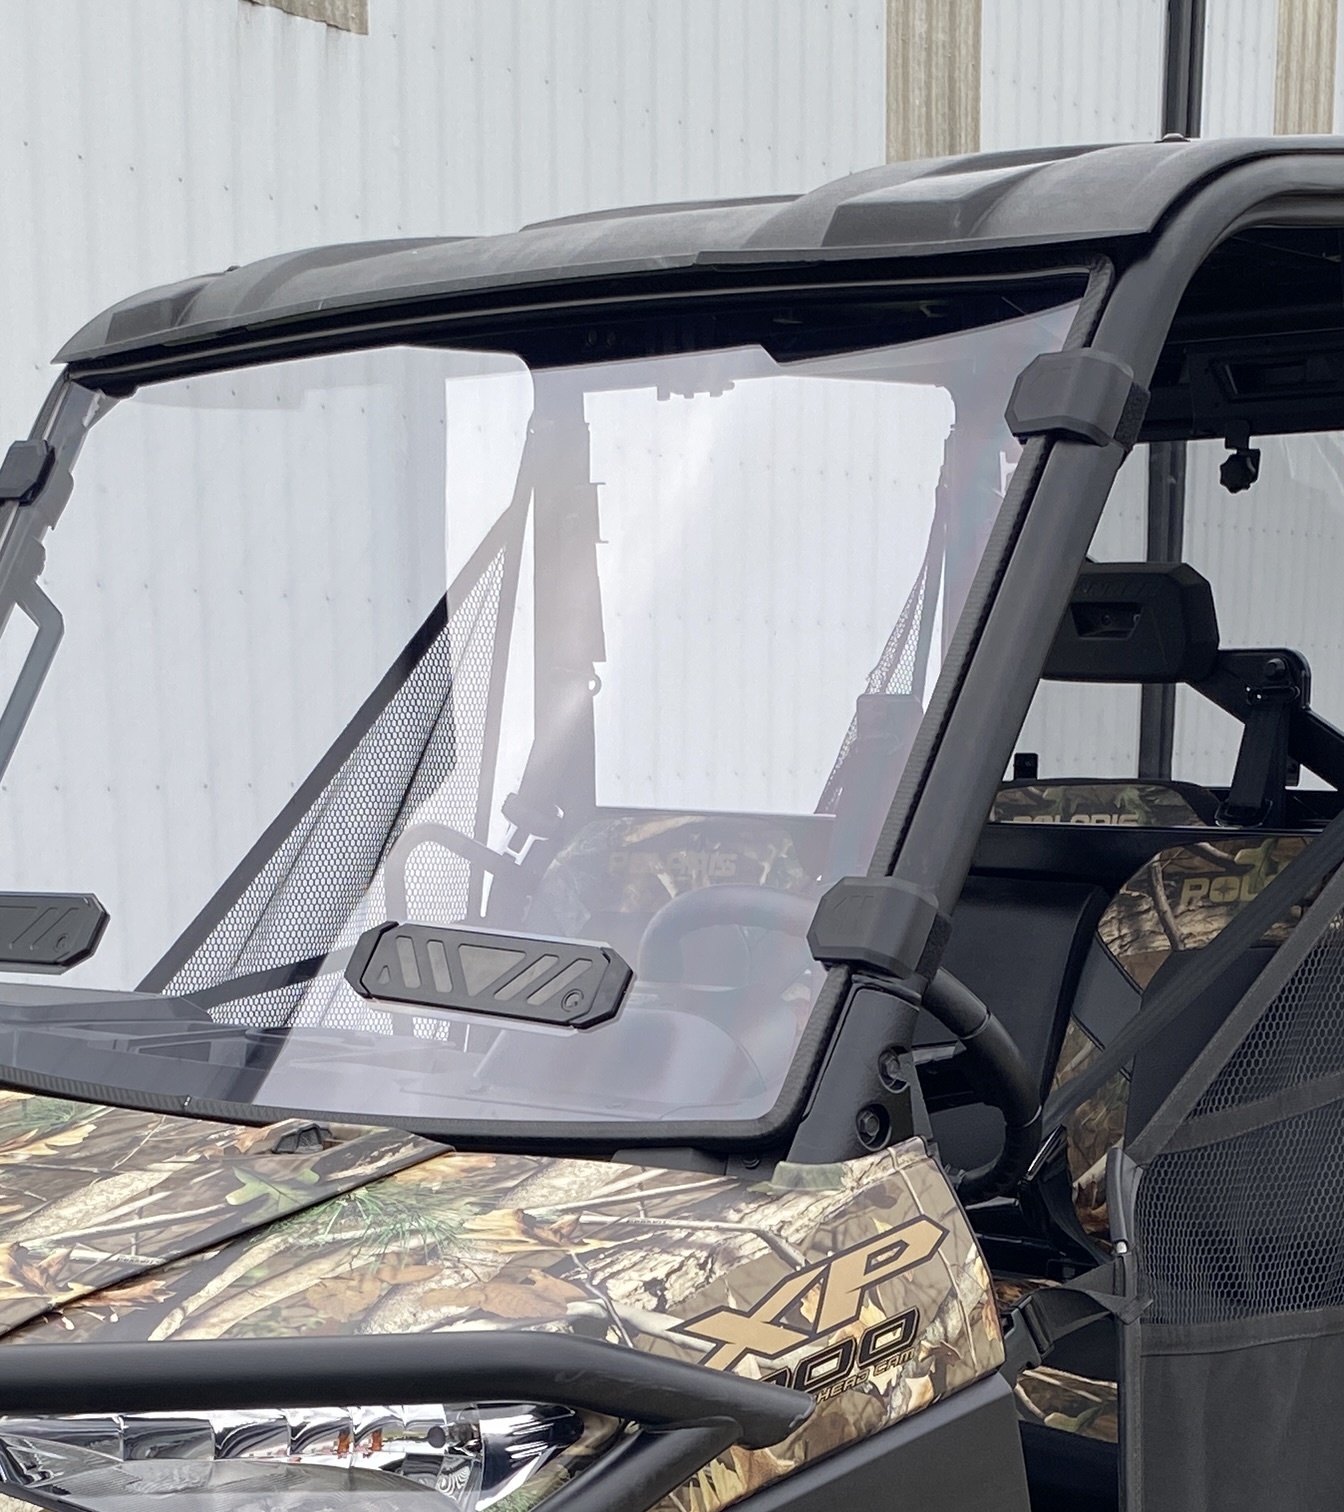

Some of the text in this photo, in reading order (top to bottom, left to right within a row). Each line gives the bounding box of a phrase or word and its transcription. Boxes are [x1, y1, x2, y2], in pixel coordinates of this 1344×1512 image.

[667, 1214, 951, 1371] XP
[815, 1348, 916, 1405] HEAD CAM
